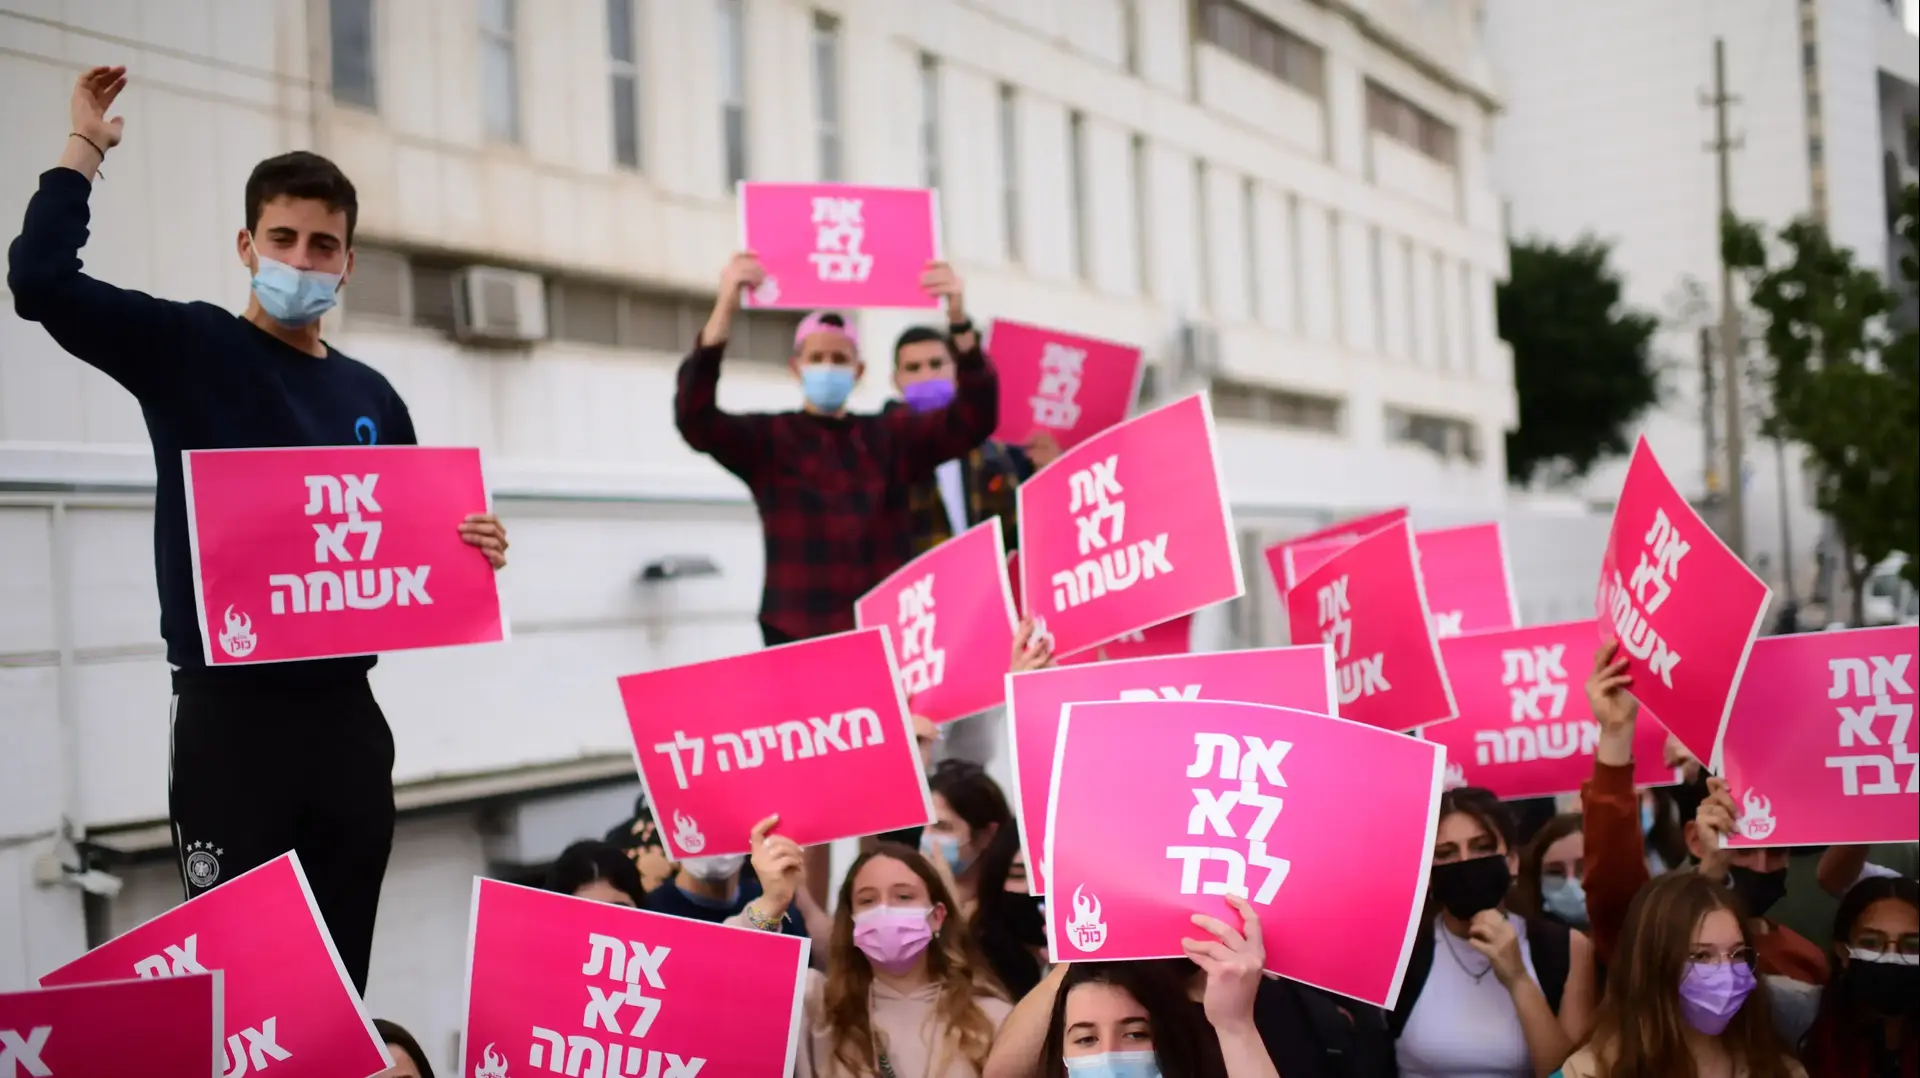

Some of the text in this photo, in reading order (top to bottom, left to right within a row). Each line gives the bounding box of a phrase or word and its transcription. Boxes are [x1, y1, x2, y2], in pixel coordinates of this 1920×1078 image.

[810, 197, 865, 223] את
[817, 222, 864, 253] לא
[807, 251, 874, 281] לבד
[304, 473, 382, 515] את
[1068, 454, 1124, 514] את
[312, 511, 382, 563] לא
[1075, 498, 1126, 556] לא
[1645, 506, 1691, 581] את
[269, 565, 434, 615] אשמה
[898, 572, 935, 627] את
[1052, 532, 1174, 613] אשמה
[1630, 550, 1672, 616] לא
[1316, 574, 1351, 628] את
[902, 608, 936, 661] לא
[1501, 643, 1568, 685] את
[1828, 654, 1915, 699] את
[1509, 679, 1568, 723] לא
[1836, 694, 1914, 747] לא
[654, 707, 885, 790] מאמינה לך
[1186, 732, 1294, 788] את
[1825, 742, 1919, 796] לבד
[1187, 780, 1284, 842] לא
[1166, 839, 1291, 906] לבד
[582, 932, 672, 990] את
[1079, 928, 1101, 946] כולן
[583, 981, 662, 1038] לא
